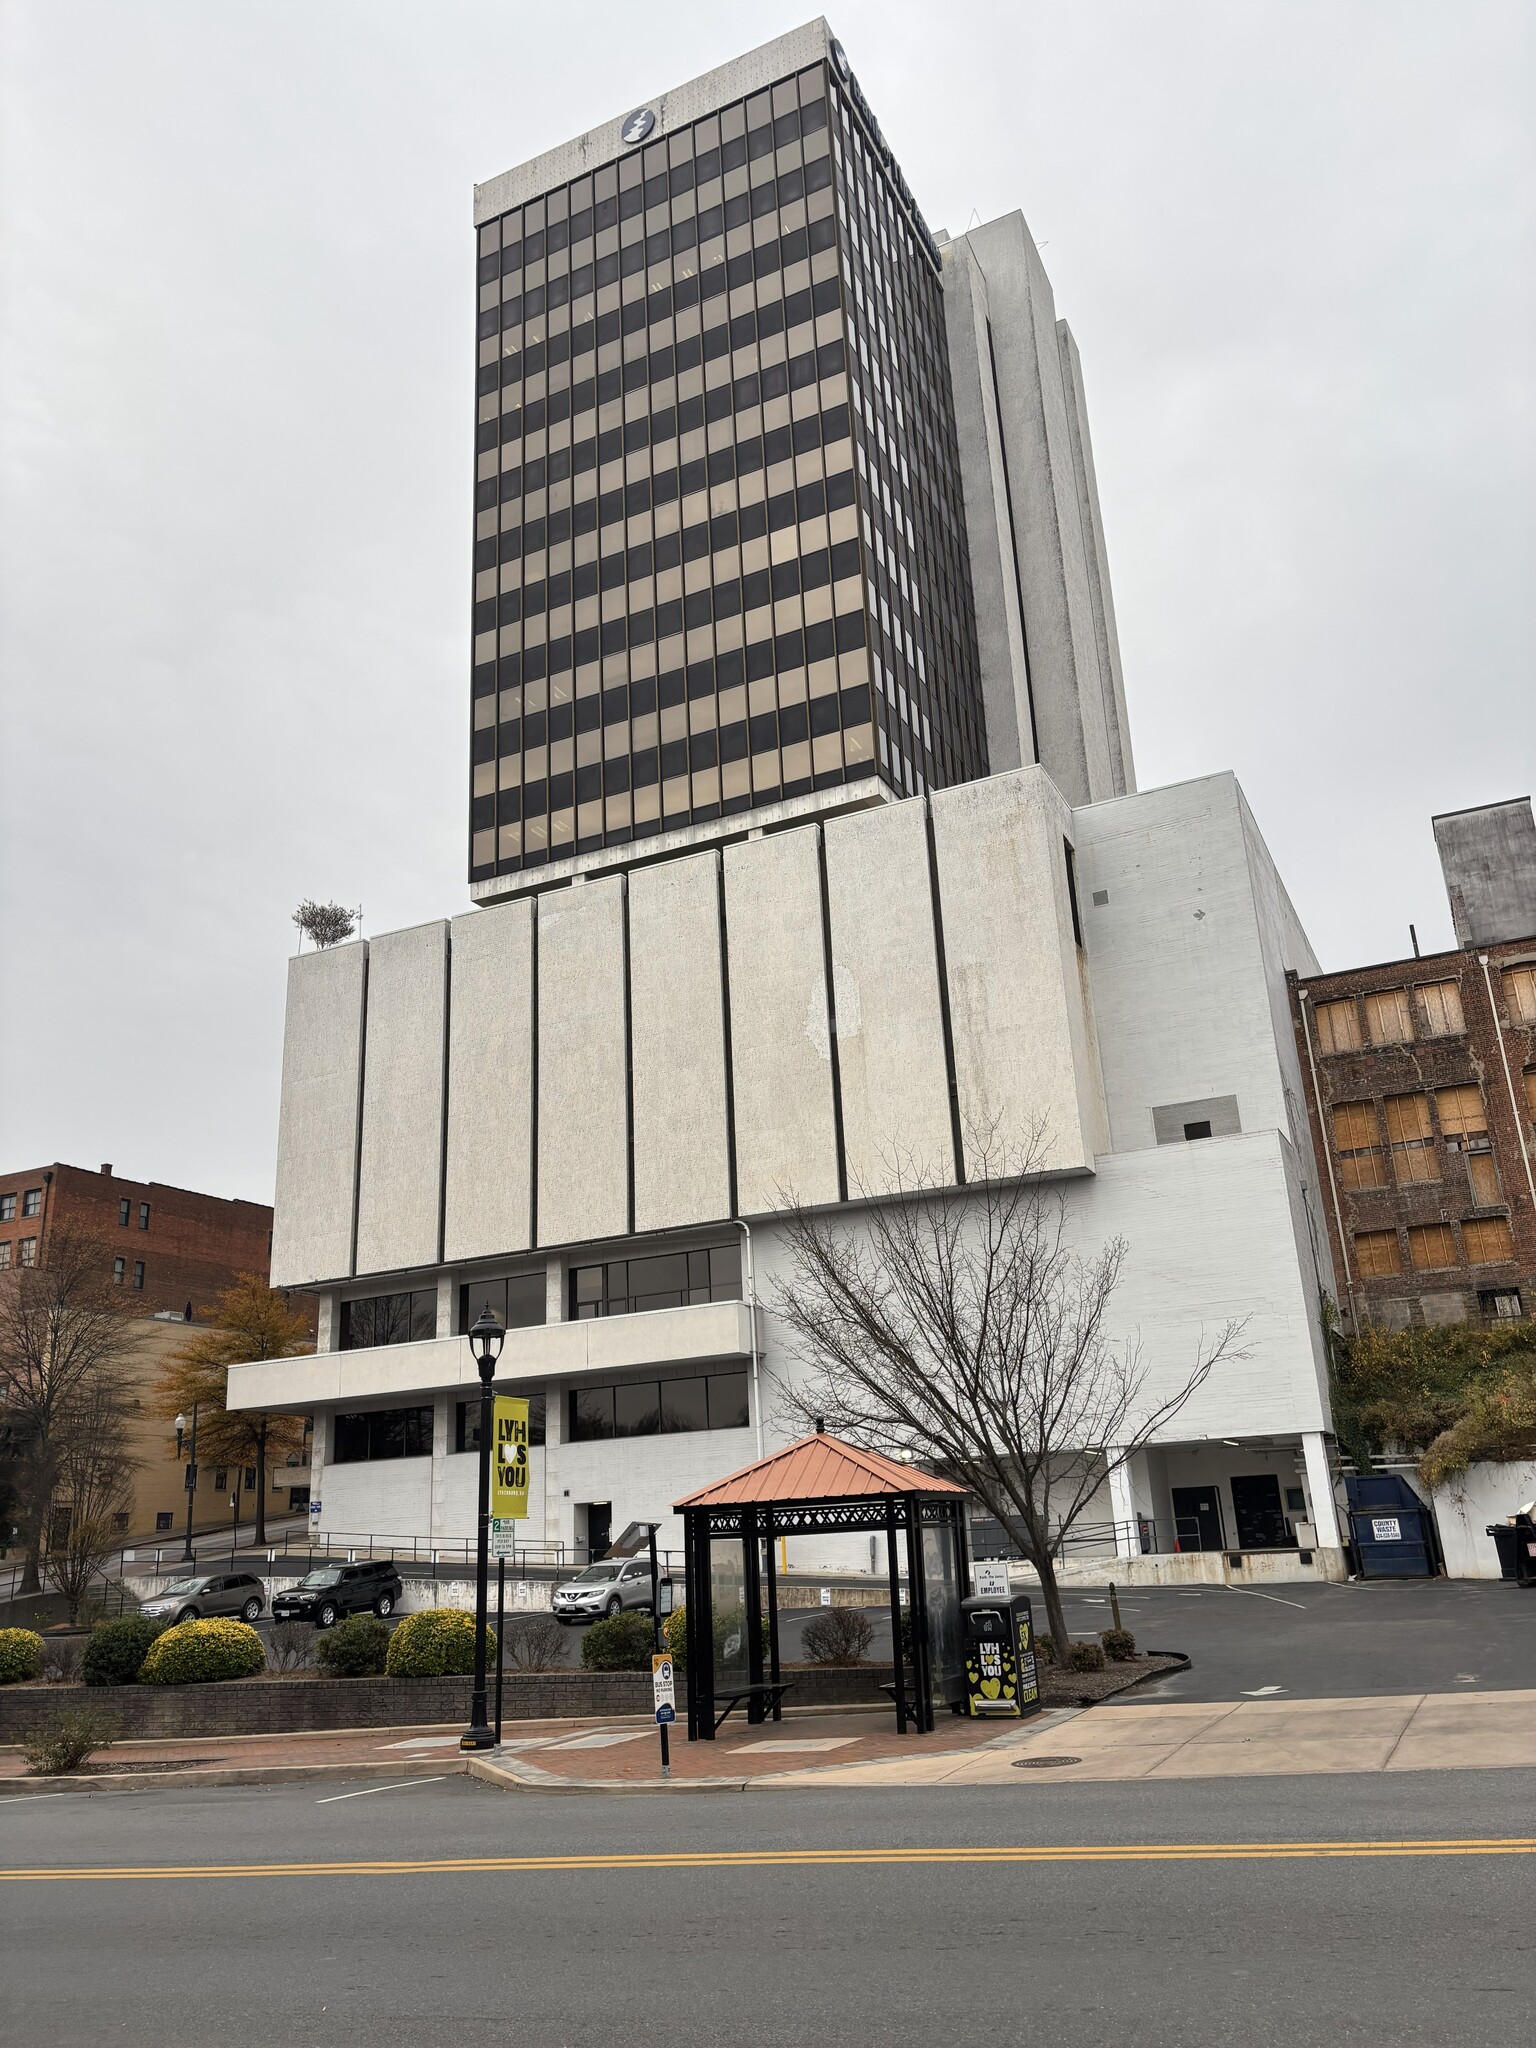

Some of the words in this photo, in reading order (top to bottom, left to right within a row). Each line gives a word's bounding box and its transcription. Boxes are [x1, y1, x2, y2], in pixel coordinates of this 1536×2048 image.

[498, 1418, 526, 1442] LYH
[497, 1466, 526, 1487] YOU
[494, 1520, 500, 1531] 2
[980, 1586, 1006, 1595] EMPLOYEE
[979, 1642, 1000, 1655] LYH
[981, 1665, 1002, 1677] YOU
